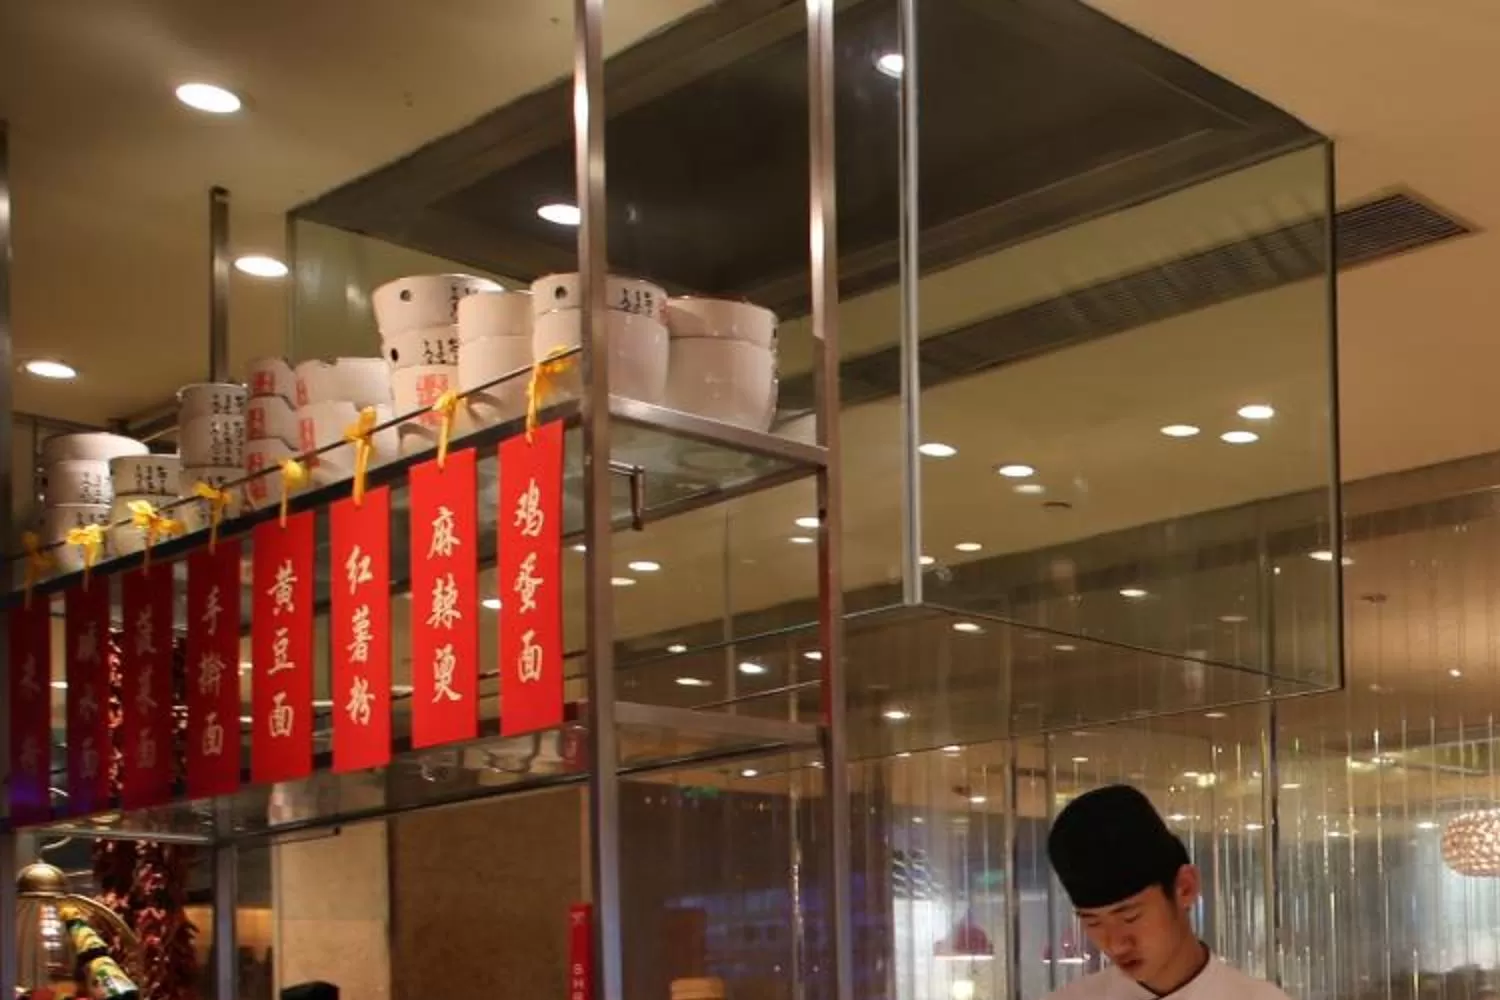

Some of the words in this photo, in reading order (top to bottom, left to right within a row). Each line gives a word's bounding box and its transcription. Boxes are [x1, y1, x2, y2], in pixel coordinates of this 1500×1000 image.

[265, 558, 298, 738] 黄豆面
[345, 544, 375, 726] 红薯粉
[426, 504, 463, 703] 麻辣烫
[513, 479, 545, 683] 鸡蛋面
